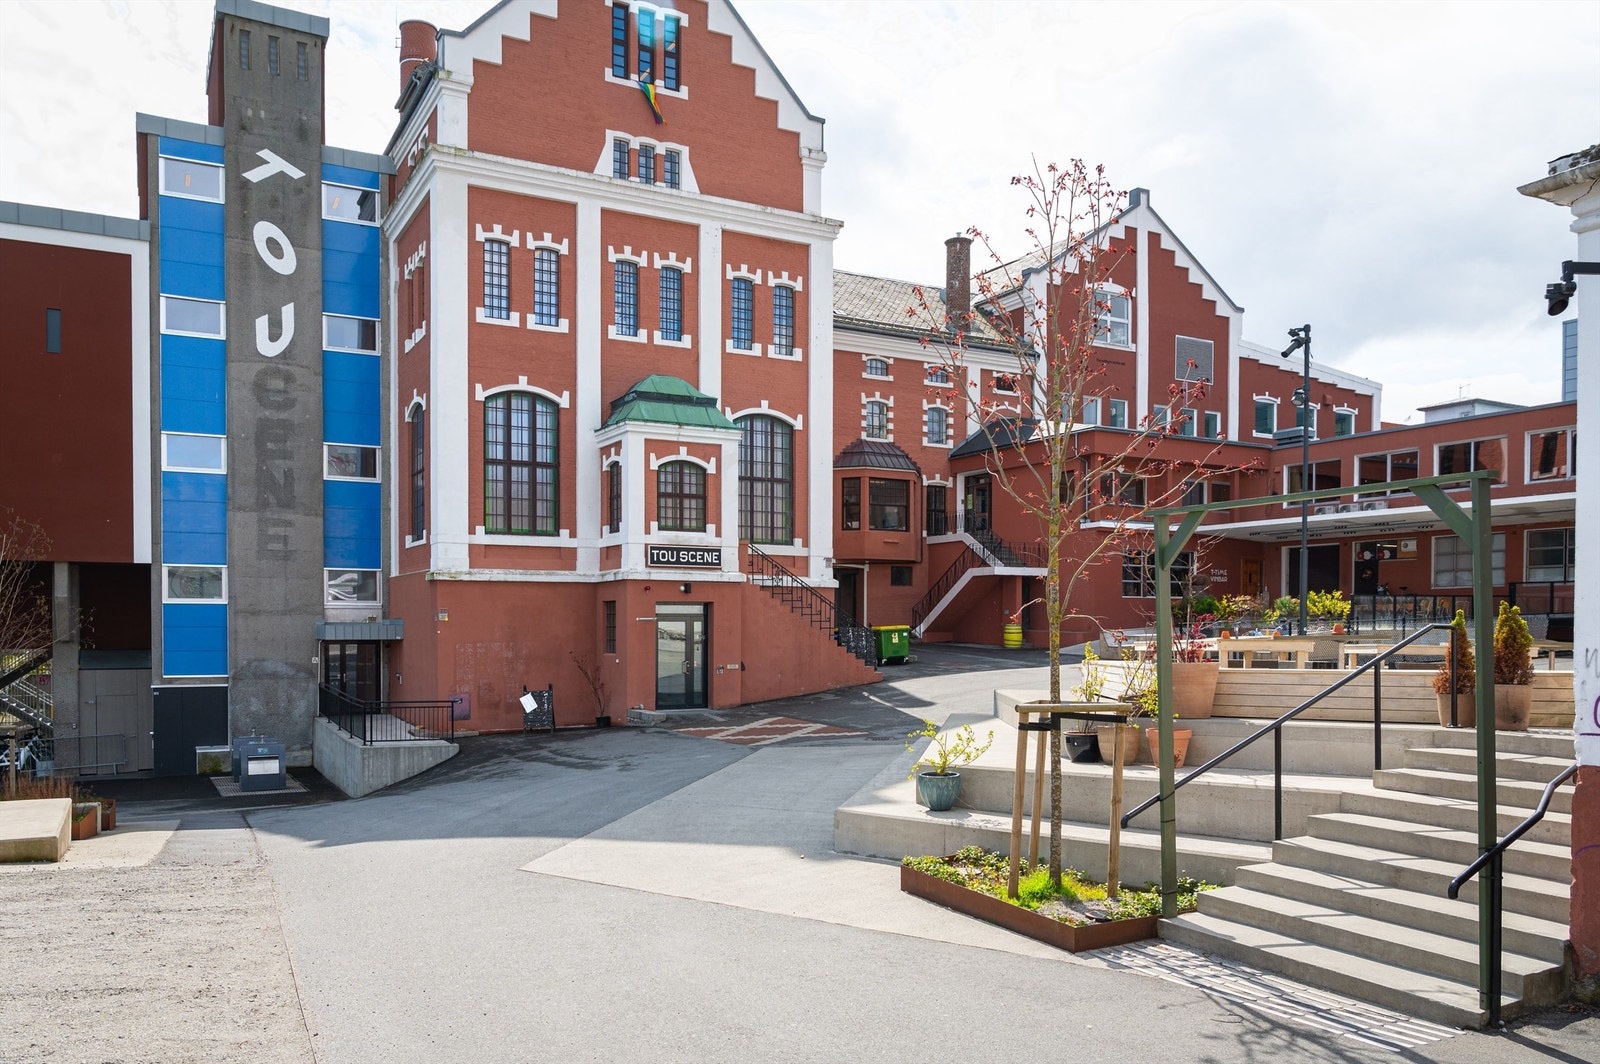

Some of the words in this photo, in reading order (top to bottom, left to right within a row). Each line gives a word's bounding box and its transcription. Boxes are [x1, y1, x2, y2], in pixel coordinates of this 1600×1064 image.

[241, 148, 306, 357] TOU
[651, 550, 677, 562] TOU
[679, 552, 719, 563] SCENE
